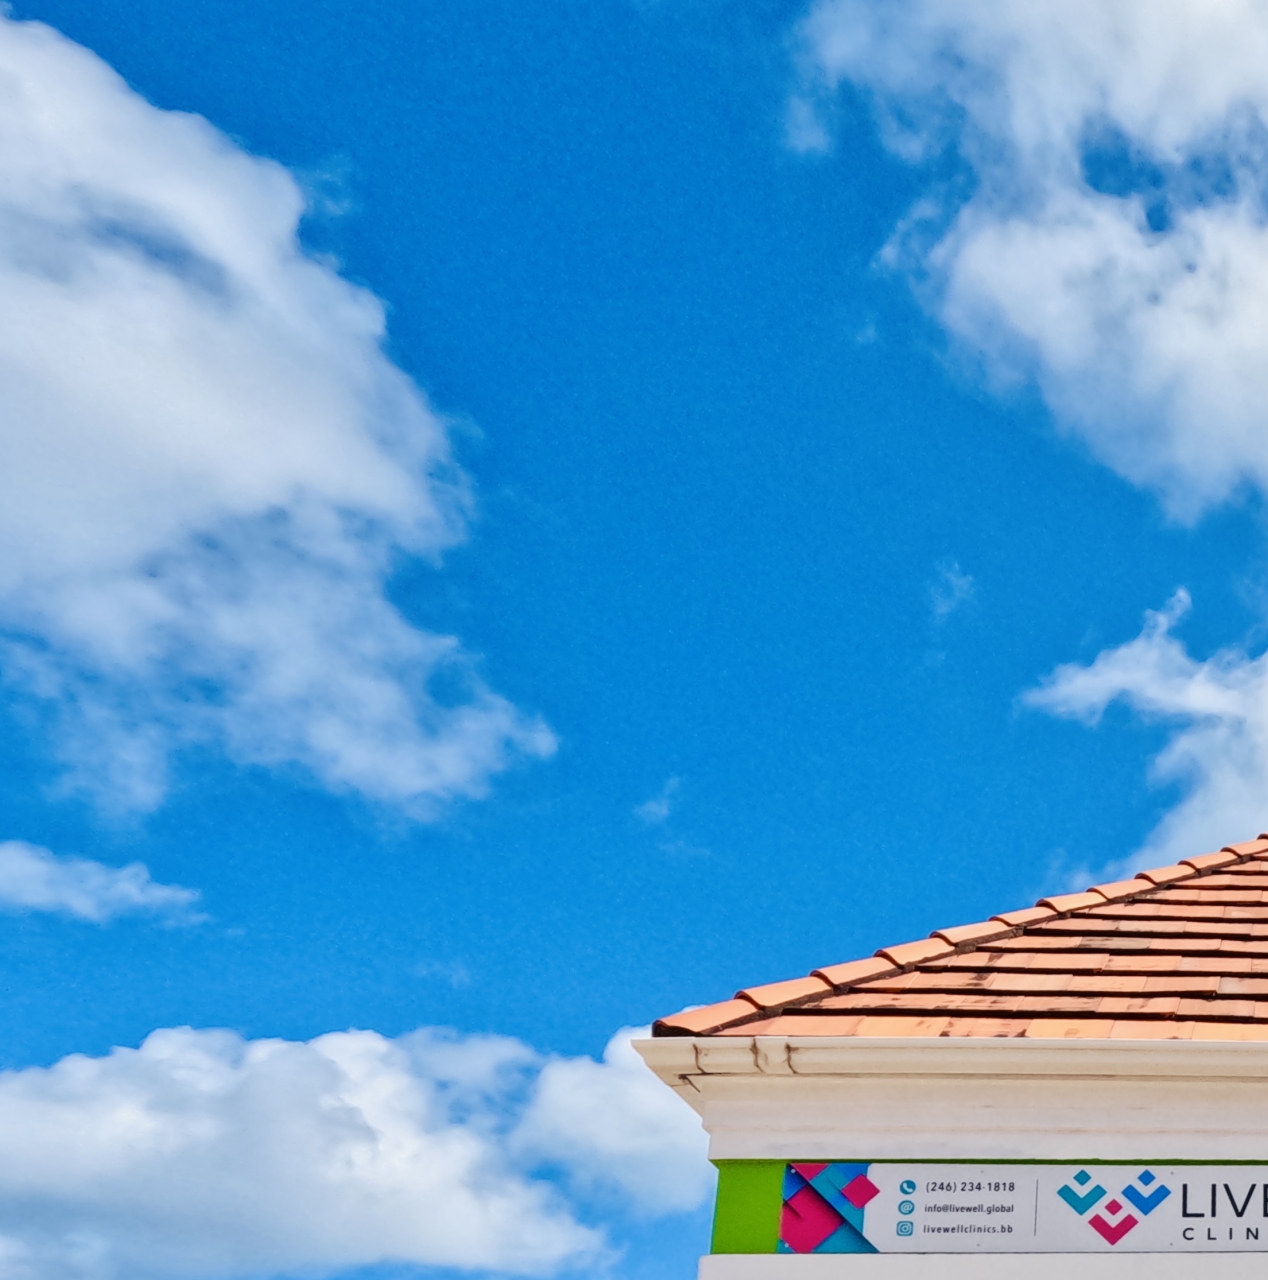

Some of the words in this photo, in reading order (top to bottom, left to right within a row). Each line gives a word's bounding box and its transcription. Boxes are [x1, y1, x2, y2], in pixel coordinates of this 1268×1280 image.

[925, 1181, 957, 1193] (246)
[960, 1181, 1015, 1192] 234-1818
[924, 1203, 1014, 1214] info@livewell.global
[923, 1224, 1013, 1234] livewellclinics.bb
